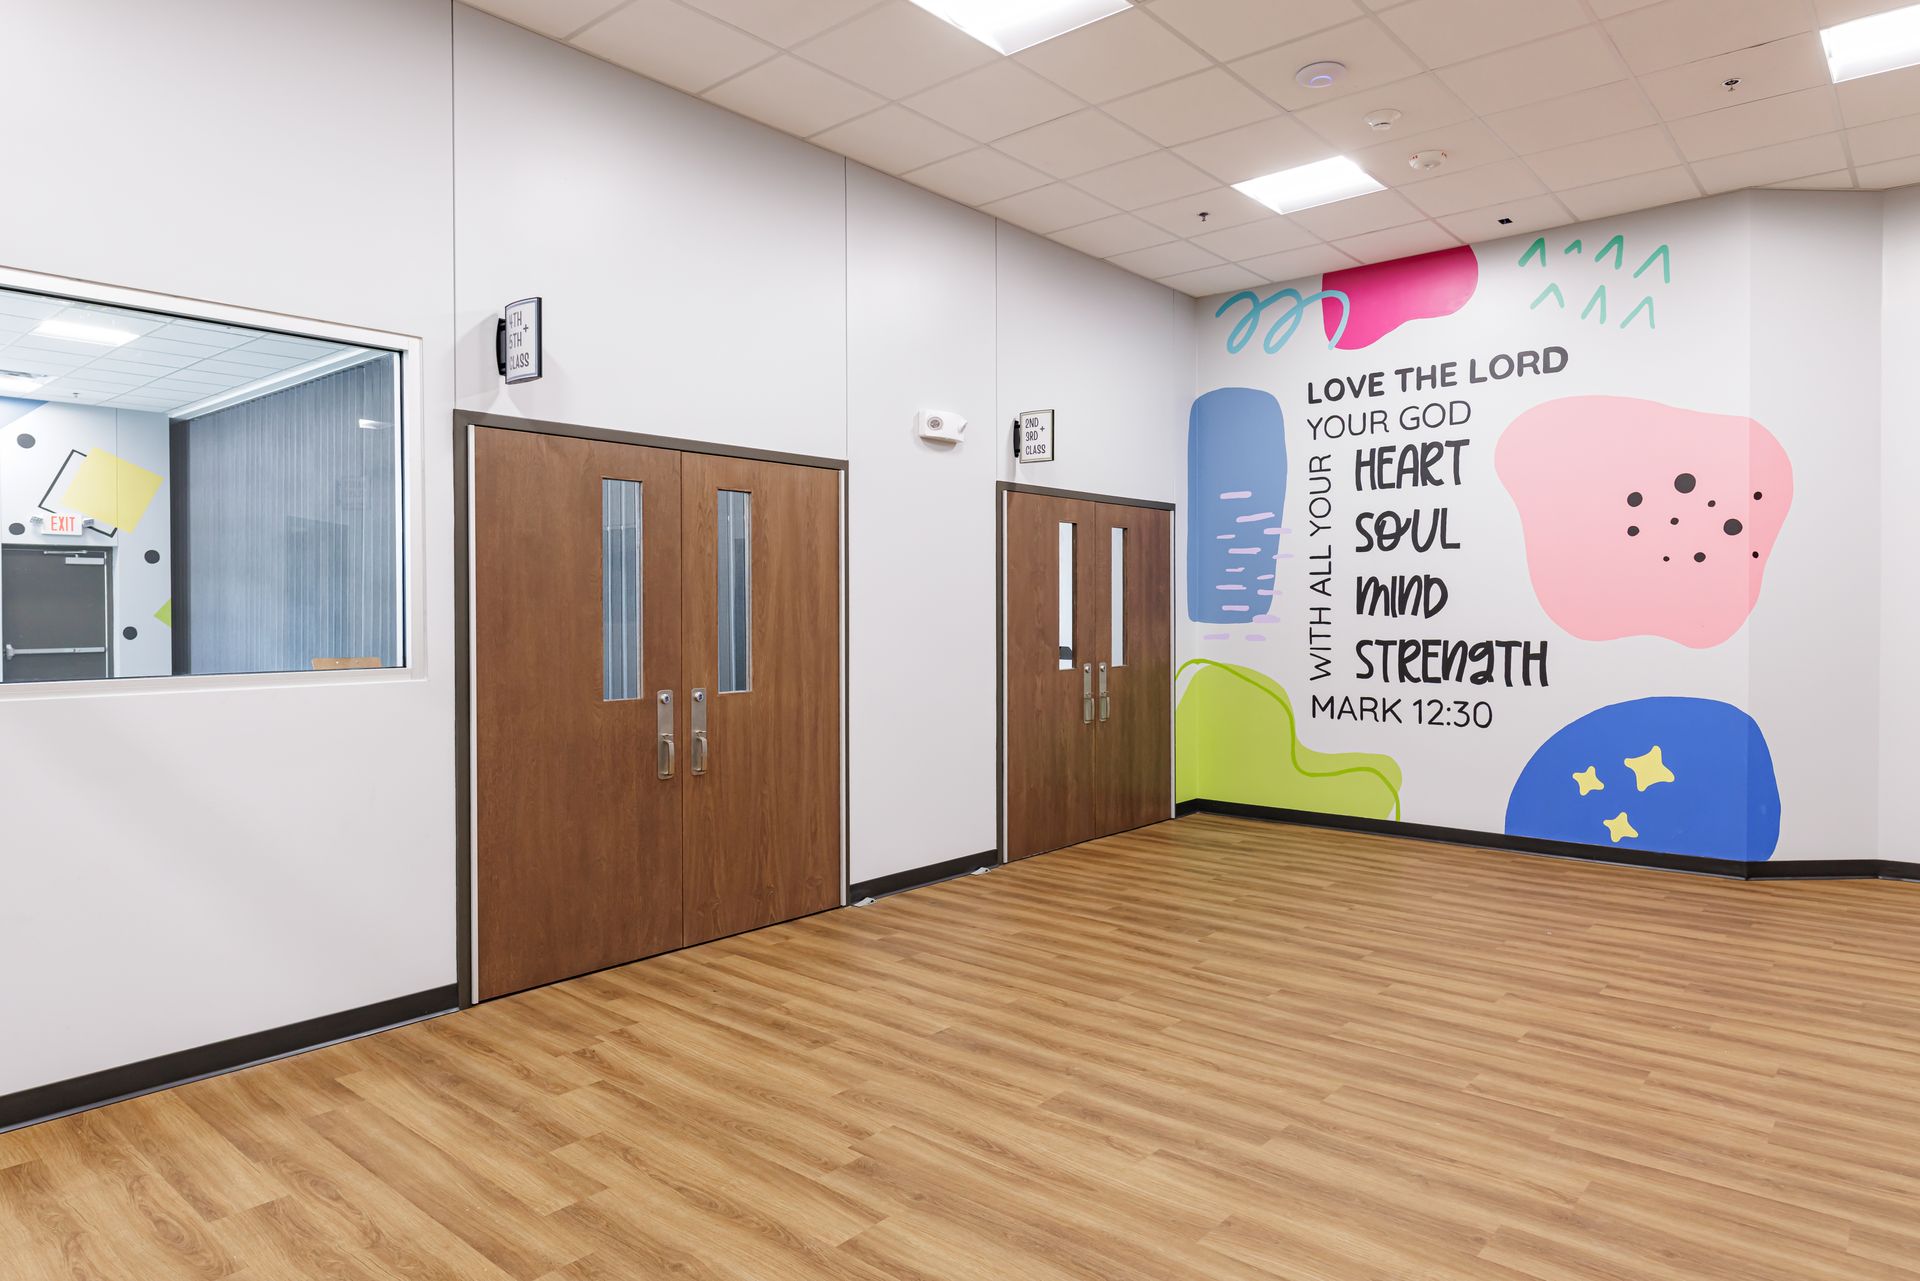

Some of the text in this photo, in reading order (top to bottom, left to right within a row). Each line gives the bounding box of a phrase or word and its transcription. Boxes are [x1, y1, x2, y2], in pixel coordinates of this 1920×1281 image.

[508, 311, 522, 328] 4TH
[509, 332, 522, 349] 5TH
[509, 352, 530, 370] CLASS
[1307, 346, 1569, 404] LOVE THE LORD
[1025, 417, 1039, 428] 2ND
[1025, 431, 1039, 441] 3RD
[1306, 400, 1472, 440] YOUR GOD
[1025, 444, 1046, 455] CLASS
[1355, 438, 1470, 491] HEART
[51, 515, 75, 531] EXIT
[1355, 507, 1461, 553] SOUL
[1309, 454, 1332, 681] WITH ALL YOUR
[1355, 574, 1449, 619] MIND
[1355, 638, 1549, 688] STRENGTH
[1311, 694, 1493, 729] MARK 12:30
